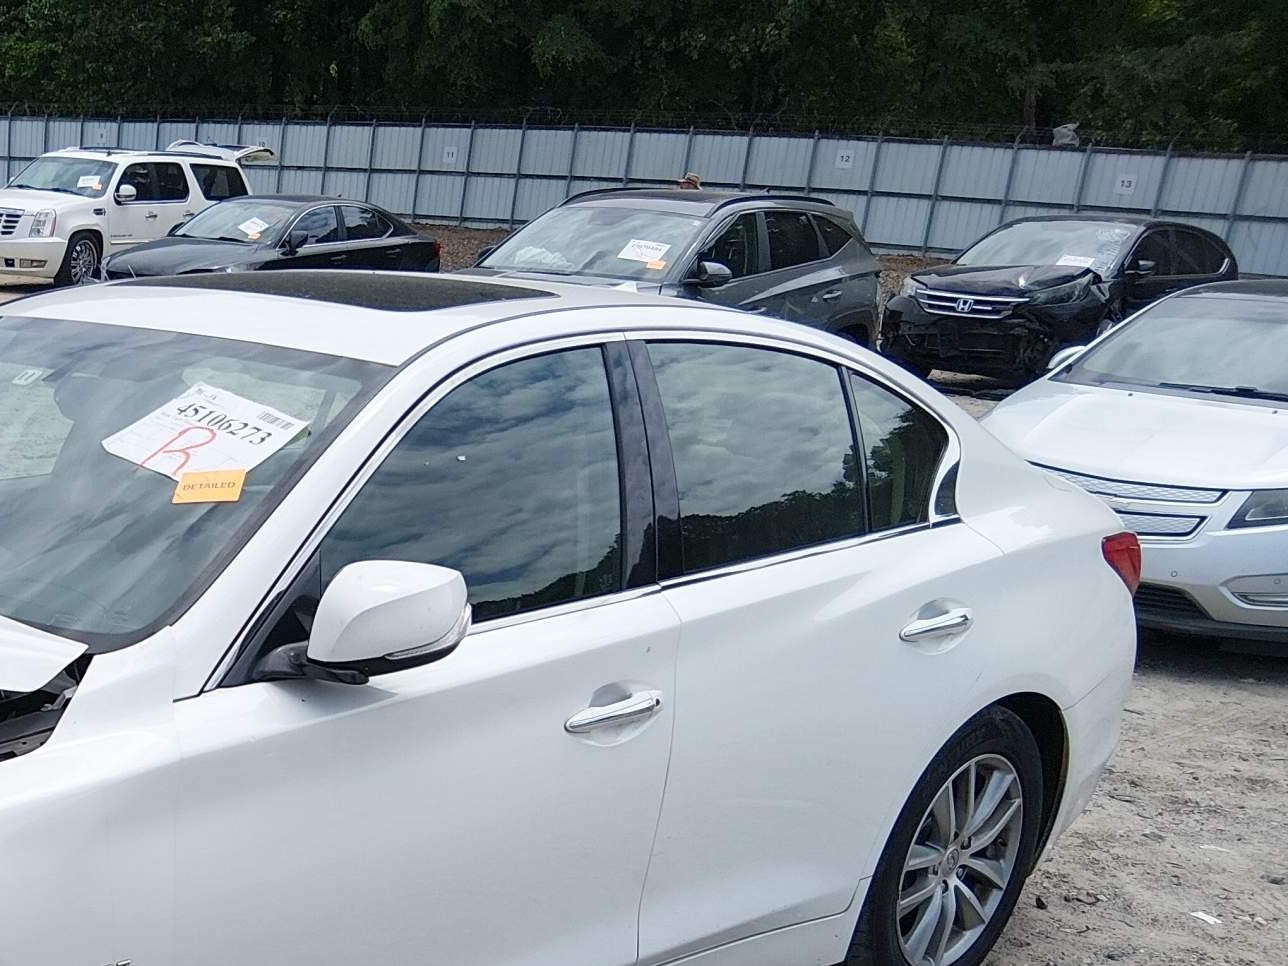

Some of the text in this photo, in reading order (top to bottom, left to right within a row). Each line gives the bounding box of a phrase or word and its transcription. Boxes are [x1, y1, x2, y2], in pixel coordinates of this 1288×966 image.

[447, 151, 455, 159] 11
[1120, 179, 1133, 188] 13
[177, 403, 272, 446] 45106273
[182, 481, 236, 491] DETAILED
